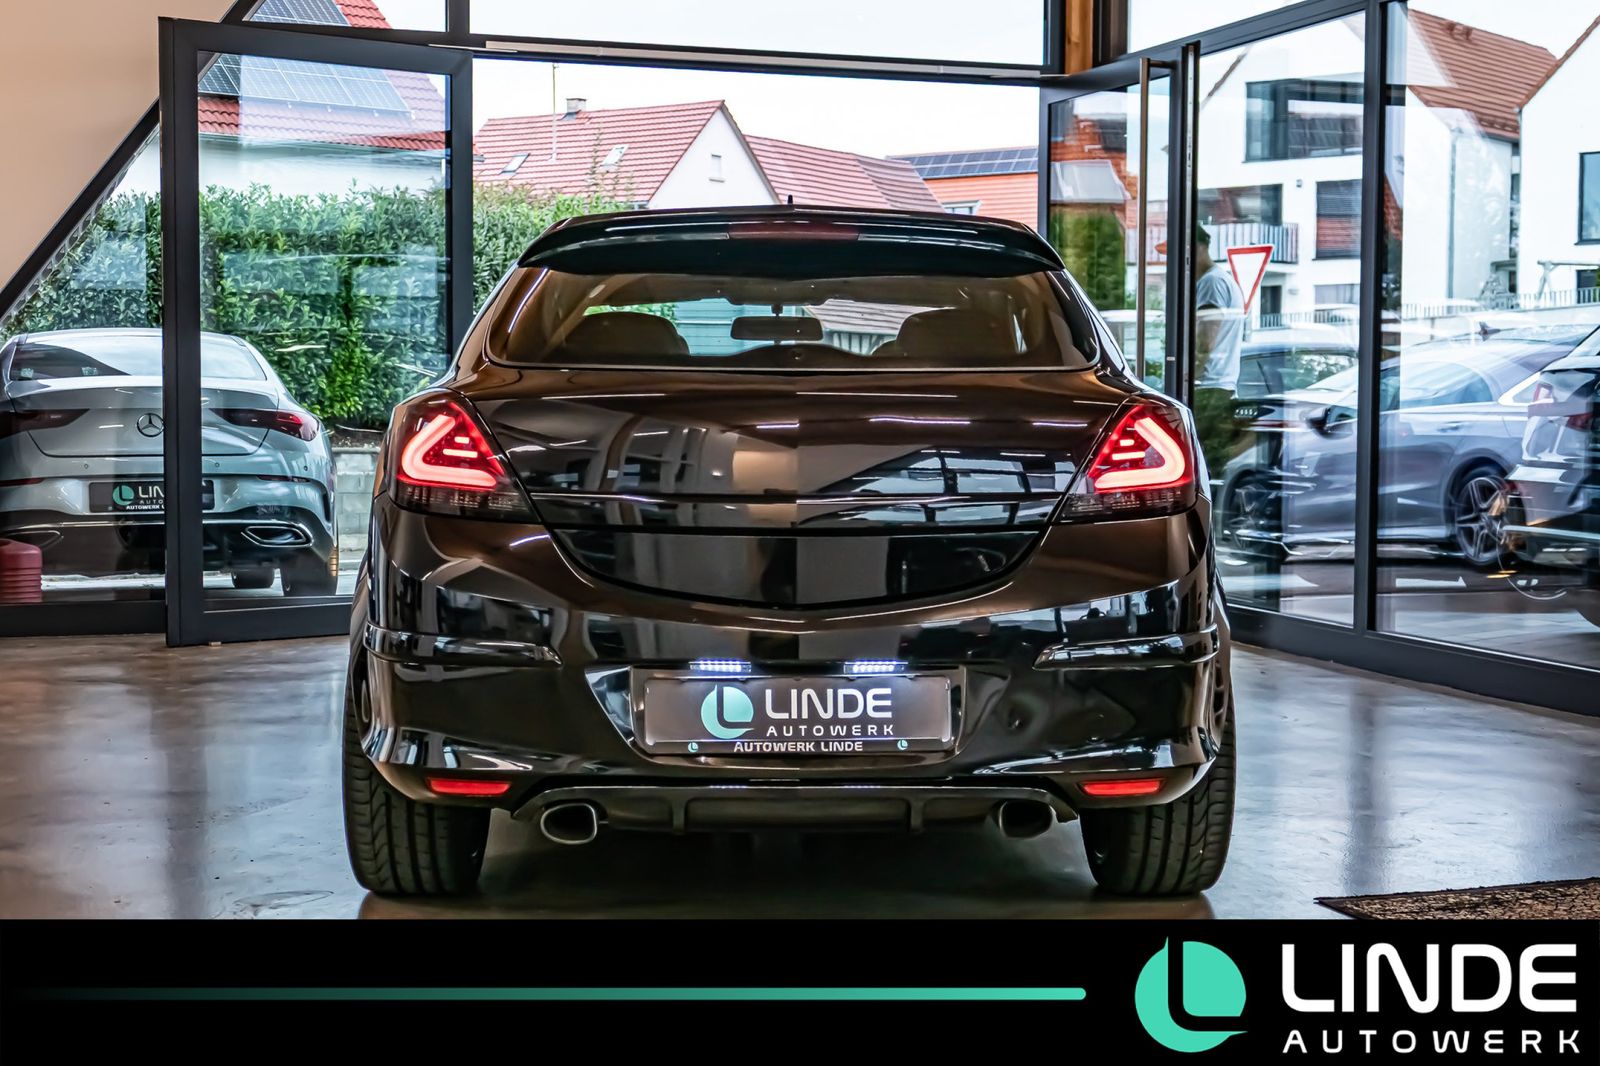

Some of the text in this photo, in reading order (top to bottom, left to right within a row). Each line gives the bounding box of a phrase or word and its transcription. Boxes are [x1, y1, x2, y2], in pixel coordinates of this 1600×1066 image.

[765, 687, 893, 719] LINDE
[766, 724, 894, 737] AUTOWERK
[733, 741, 864, 753] AUTOWERK LINDE
